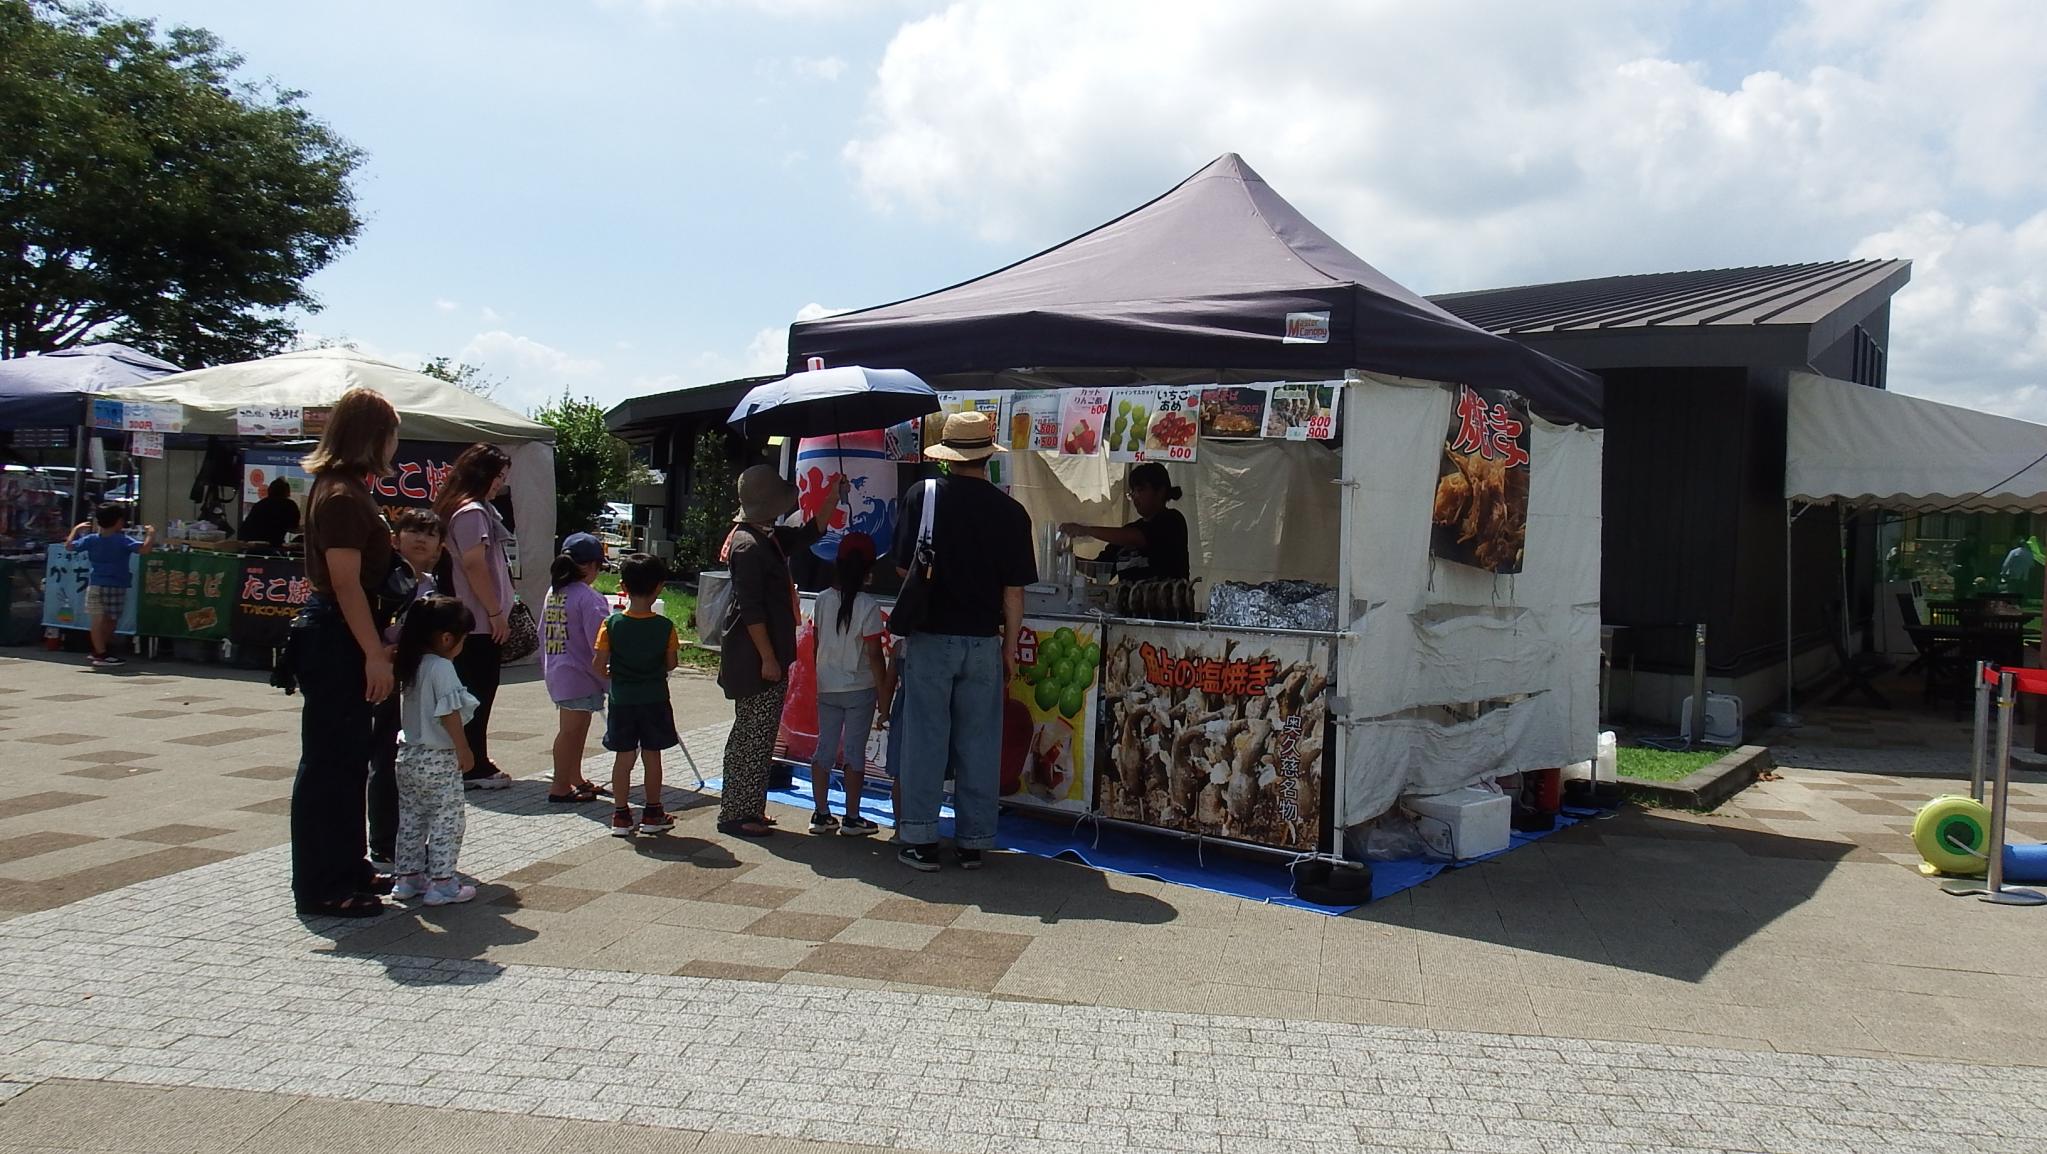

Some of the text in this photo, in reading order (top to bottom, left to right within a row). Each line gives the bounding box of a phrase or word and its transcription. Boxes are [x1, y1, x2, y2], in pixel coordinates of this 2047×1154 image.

[1157, 390, 1191, 402] いちご
[1090, 404, 1108, 415] 600
[1160, 401, 1182, 412] あめ
[1310, 416, 1332, 428] 800
[1308, 427, 1329, 438] 900
[1169, 447, 1192, 459] 600
[242, 574, 312, 604] たこ焼
[1140, 641, 1278, 697] 鮎の塩焼き
[1280, 714, 1302, 822] 奥久慈名物
